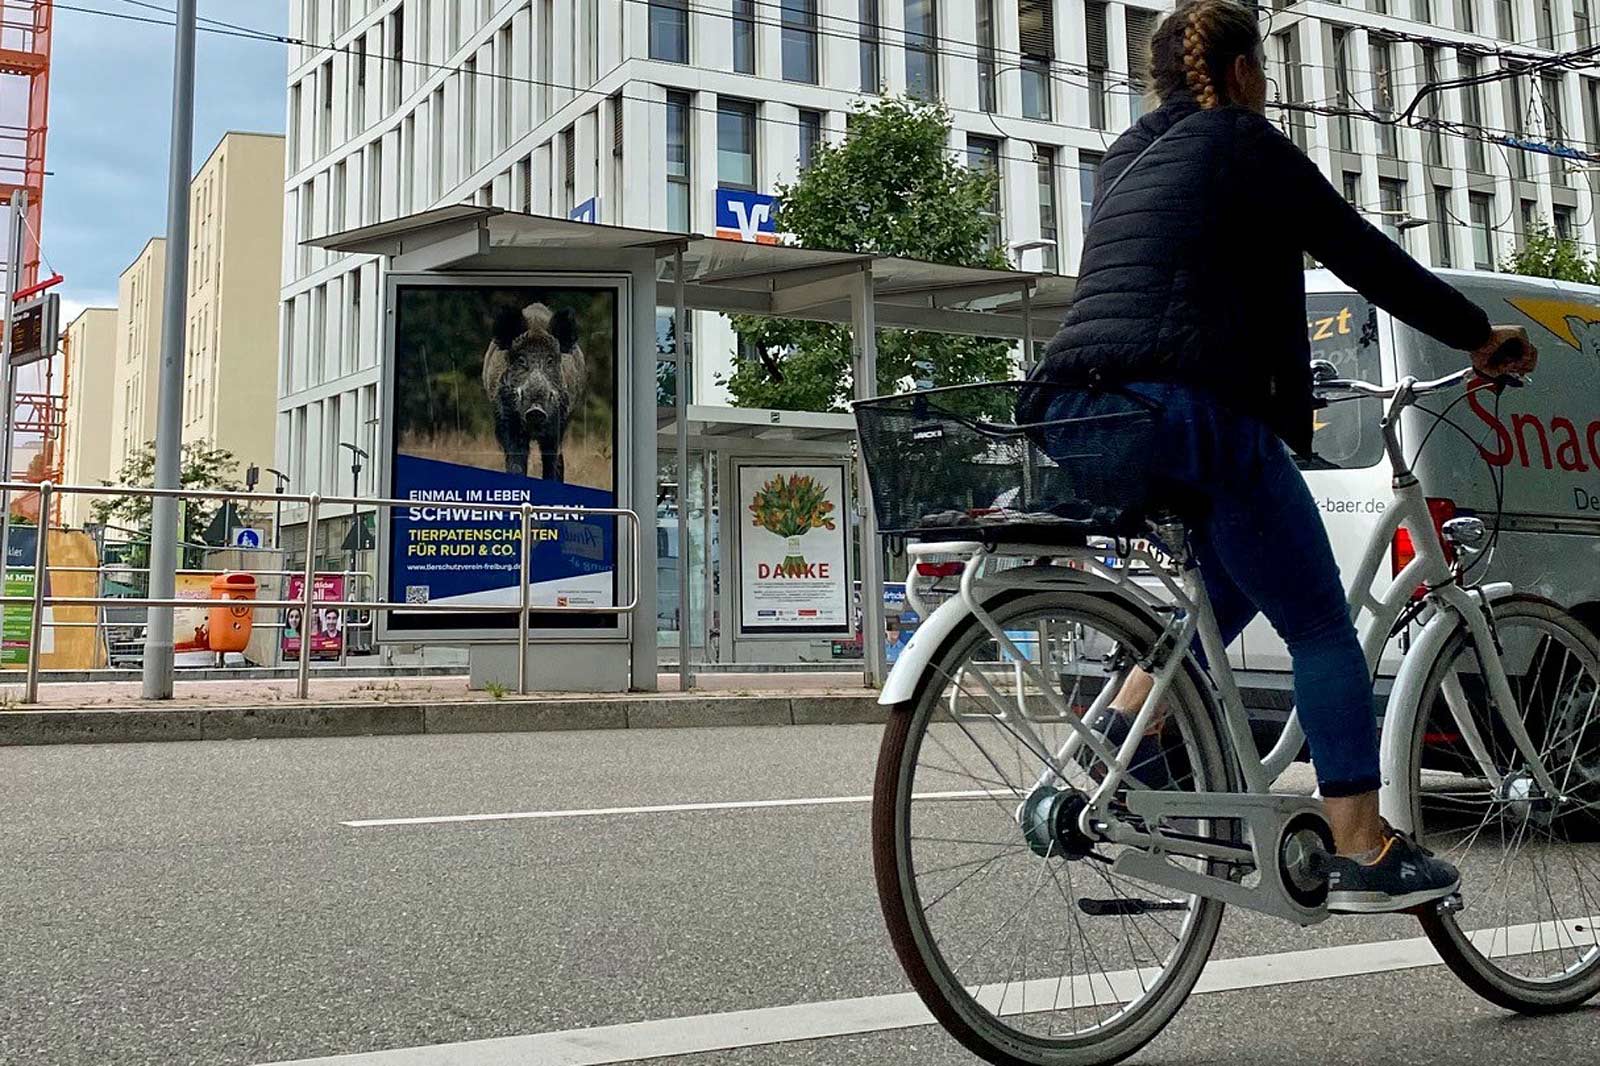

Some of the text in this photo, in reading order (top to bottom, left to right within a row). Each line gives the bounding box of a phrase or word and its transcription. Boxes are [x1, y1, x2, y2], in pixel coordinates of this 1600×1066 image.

[1308, 306, 1352, 341] zt
[409, 490, 531, 501] EINMAL IM LEBEN
[409, 506, 503, 521] SCHWEIN
[408, 529, 558, 541] TIERPATENSCHATEN
[408, 543, 516, 557] FÜR RUDI & CO.
[758, 562, 830, 580] DANKE
